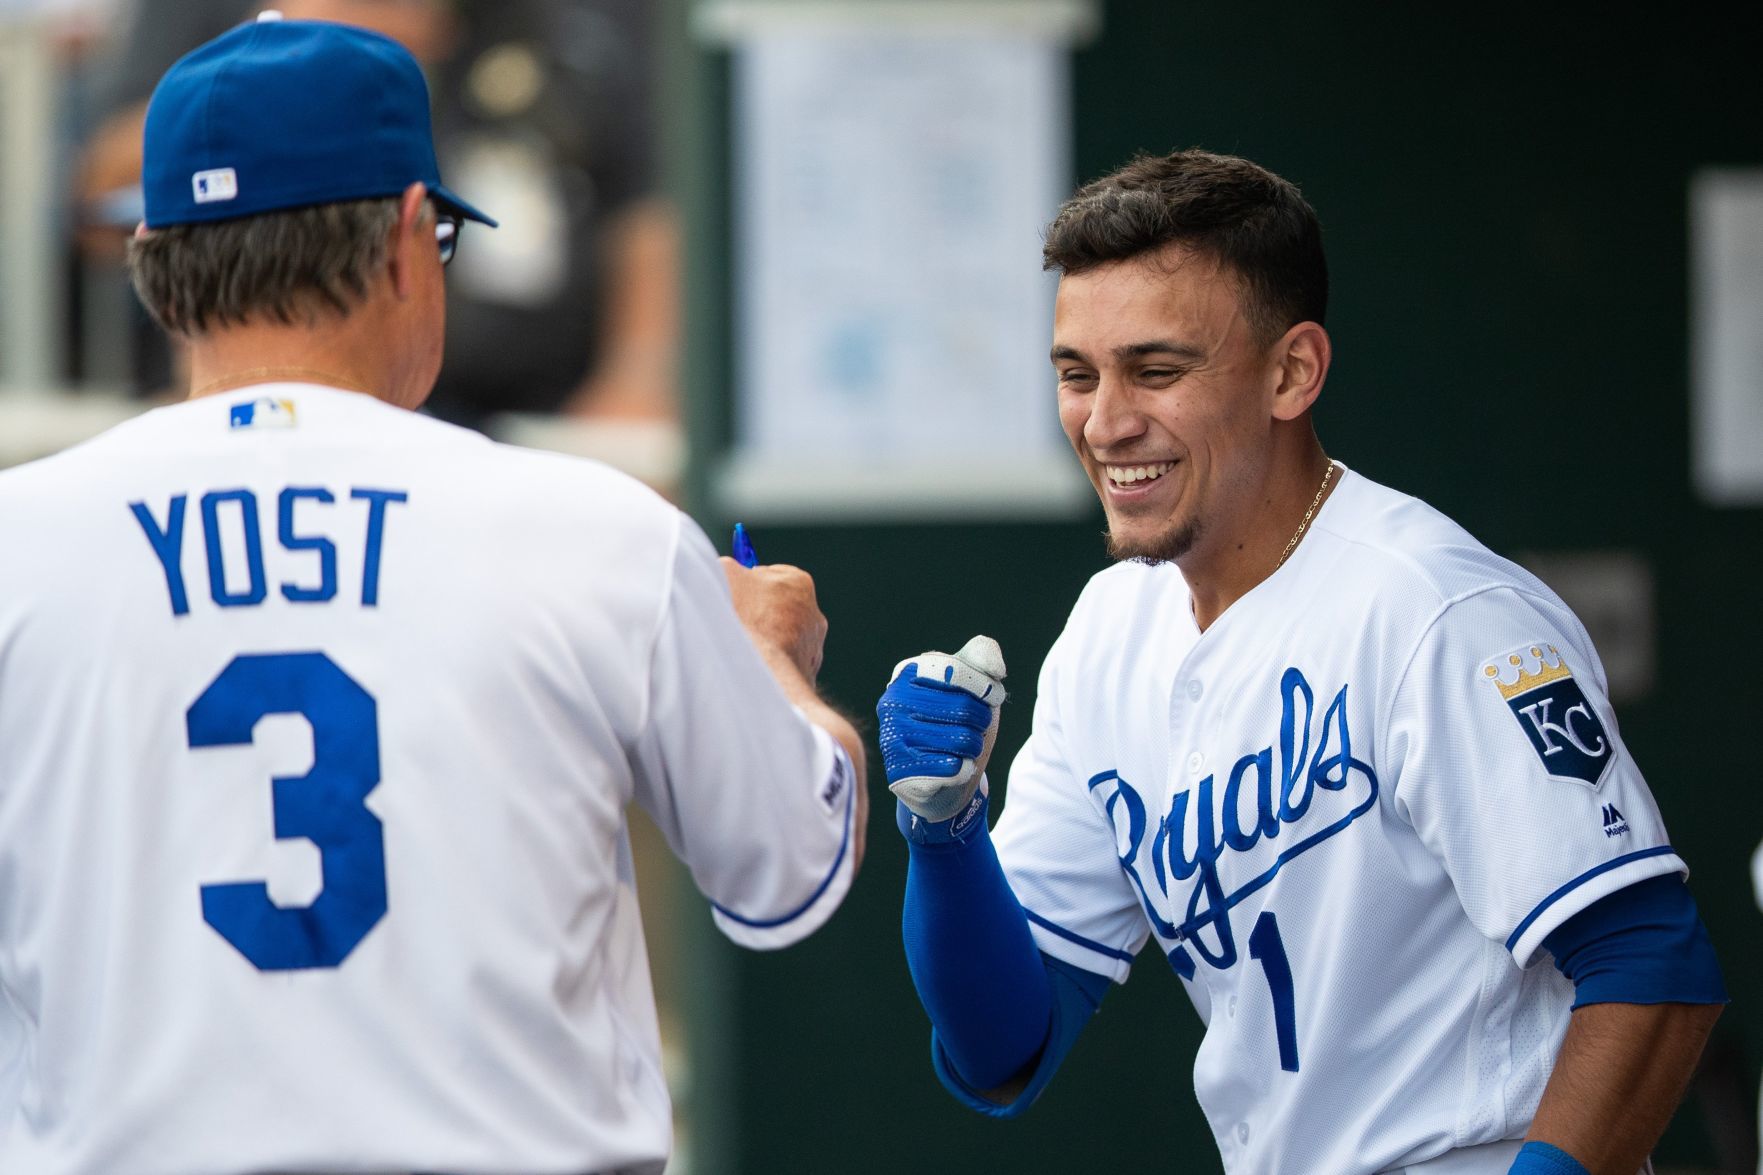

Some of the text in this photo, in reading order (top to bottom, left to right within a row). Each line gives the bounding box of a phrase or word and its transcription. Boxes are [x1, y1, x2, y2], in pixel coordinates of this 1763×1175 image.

[128, 485, 408, 617] YOST
[1518, 697, 1606, 757] KC
[186, 650, 389, 972] 3
[955, 797, 983, 830] adidas
[1249, 911, 1300, 1072] 1
